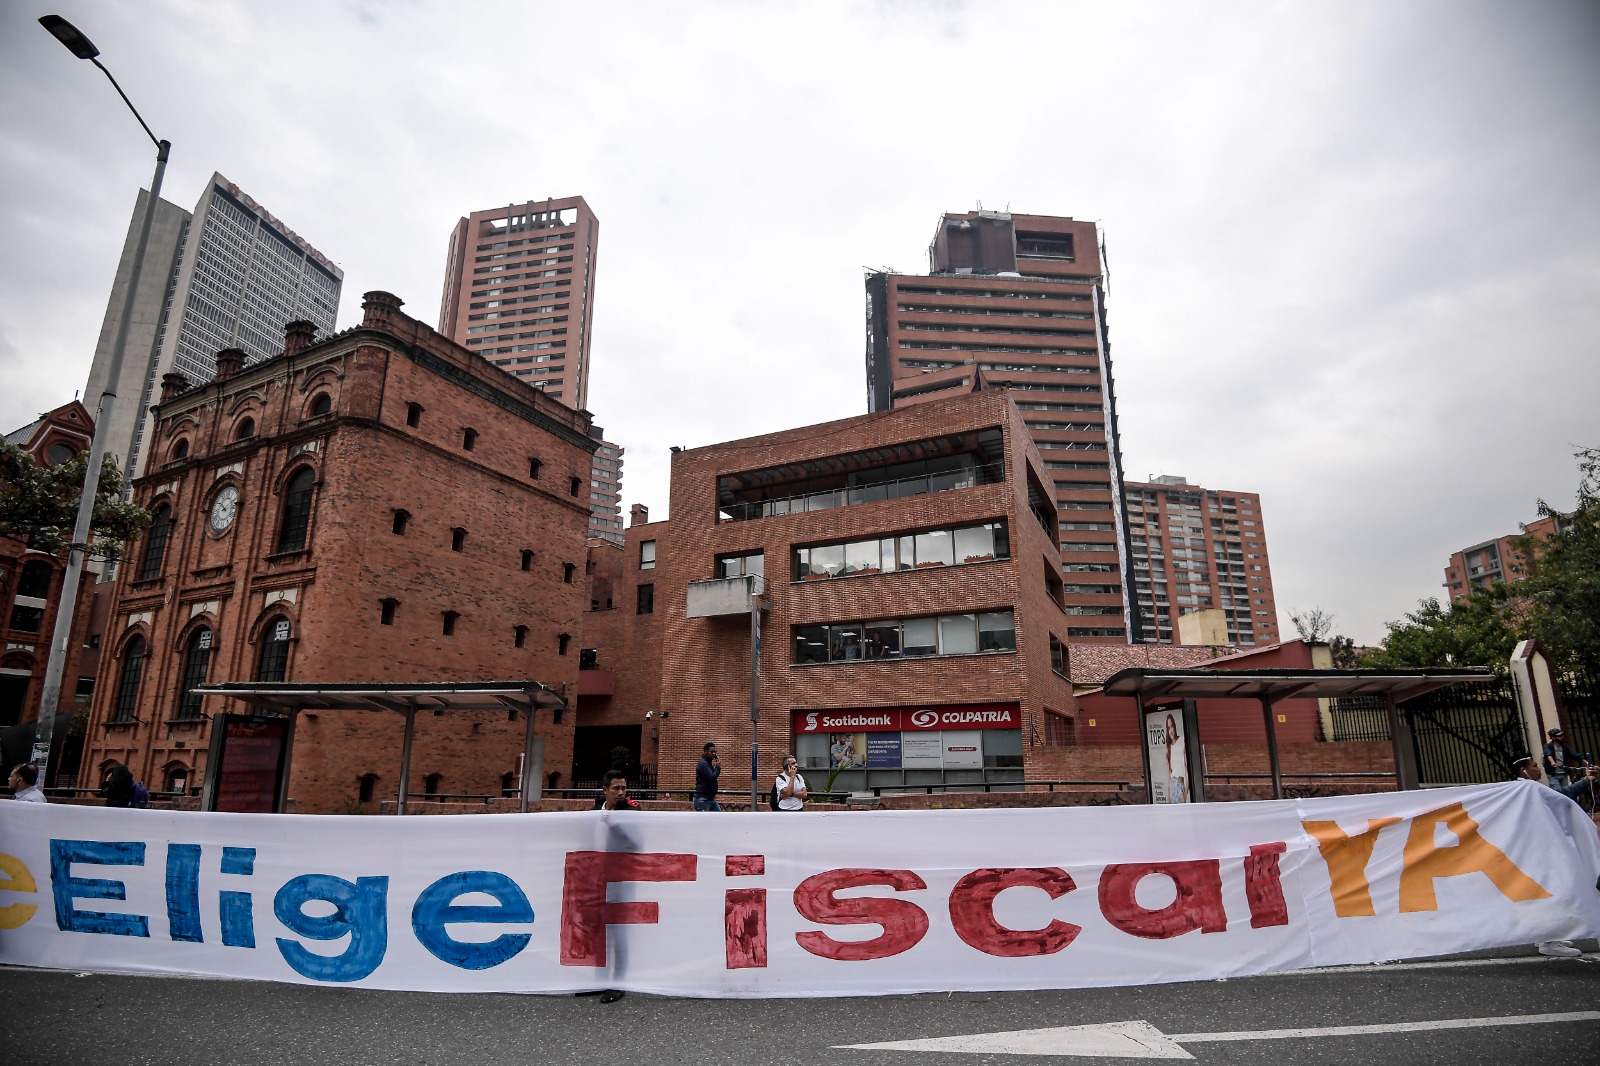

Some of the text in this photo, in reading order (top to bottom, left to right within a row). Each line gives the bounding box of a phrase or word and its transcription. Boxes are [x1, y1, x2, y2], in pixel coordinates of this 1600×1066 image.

[244, 194, 335, 273] DAVIVIENDA
[823, 714, 891, 727] Scotiabank
[942, 710, 1012, 723] COLPATRIA
[1149, 729, 1166, 745] TOPS
